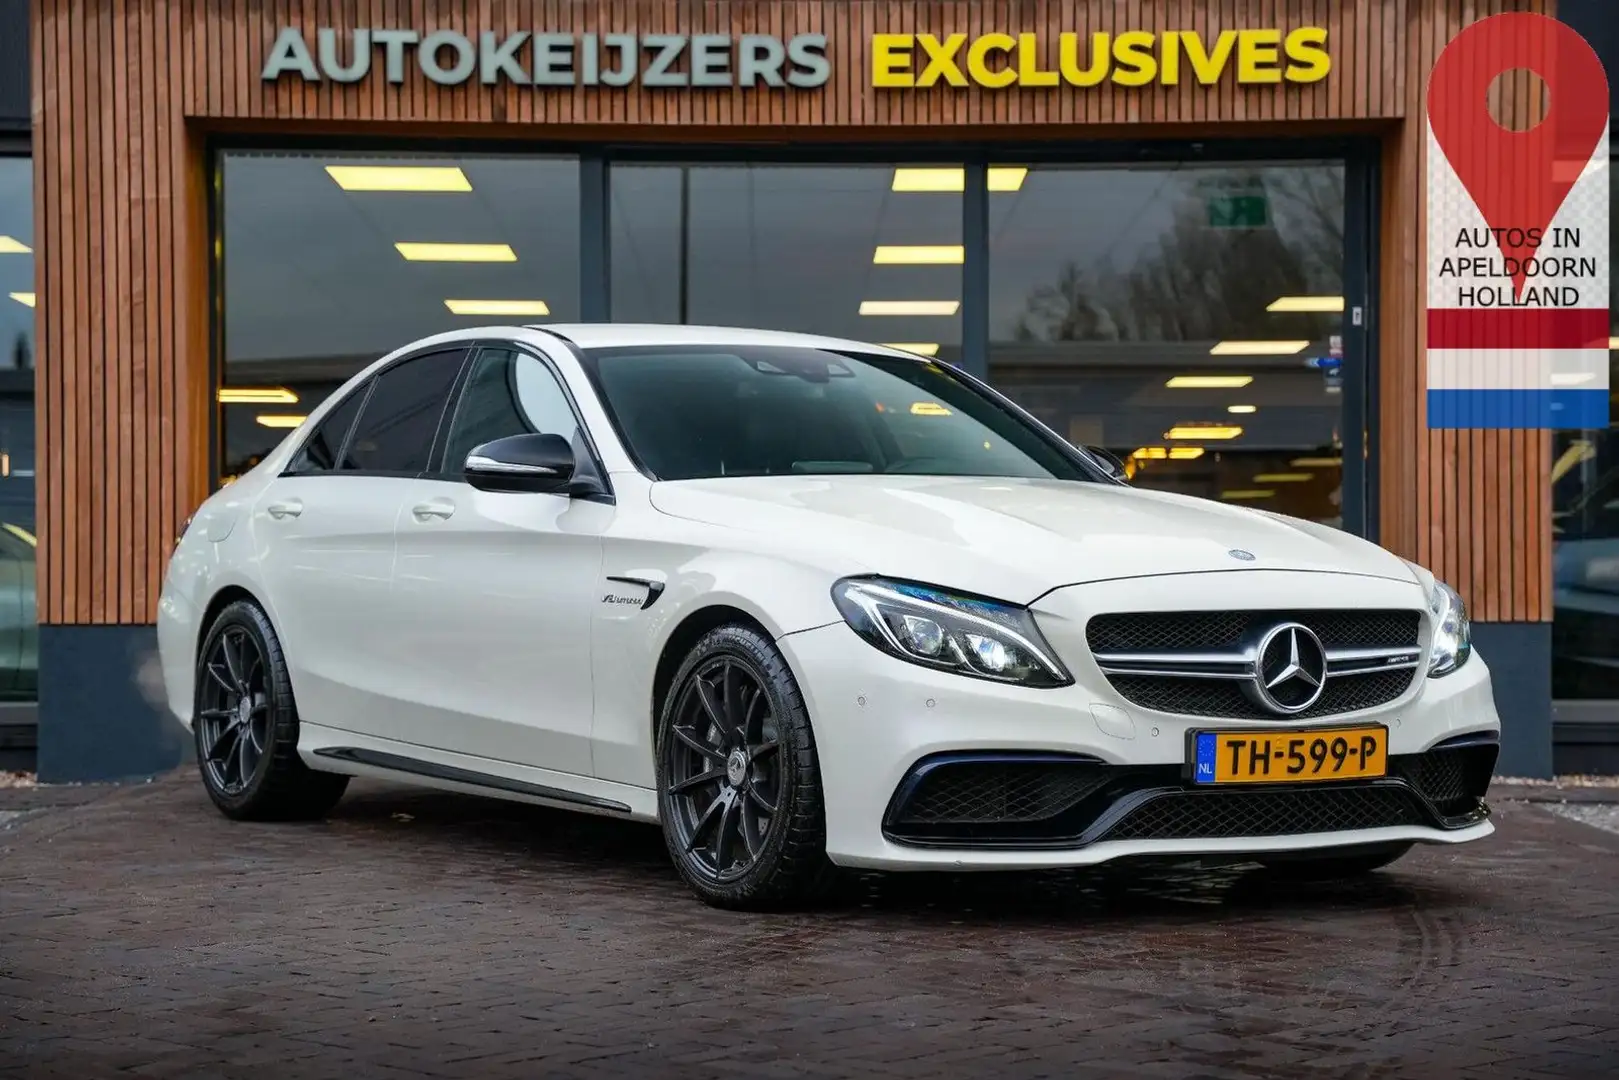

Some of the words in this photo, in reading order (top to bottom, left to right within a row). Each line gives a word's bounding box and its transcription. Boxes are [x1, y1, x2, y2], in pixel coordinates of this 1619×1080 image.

[262, 27, 832, 87] AUTOKEIJZERS
[872, 27, 1331, 88] EXCLUSIVES
[1198, 763, 1212, 774] NL
[1227, 736, 1377, 775] TH-599-P
